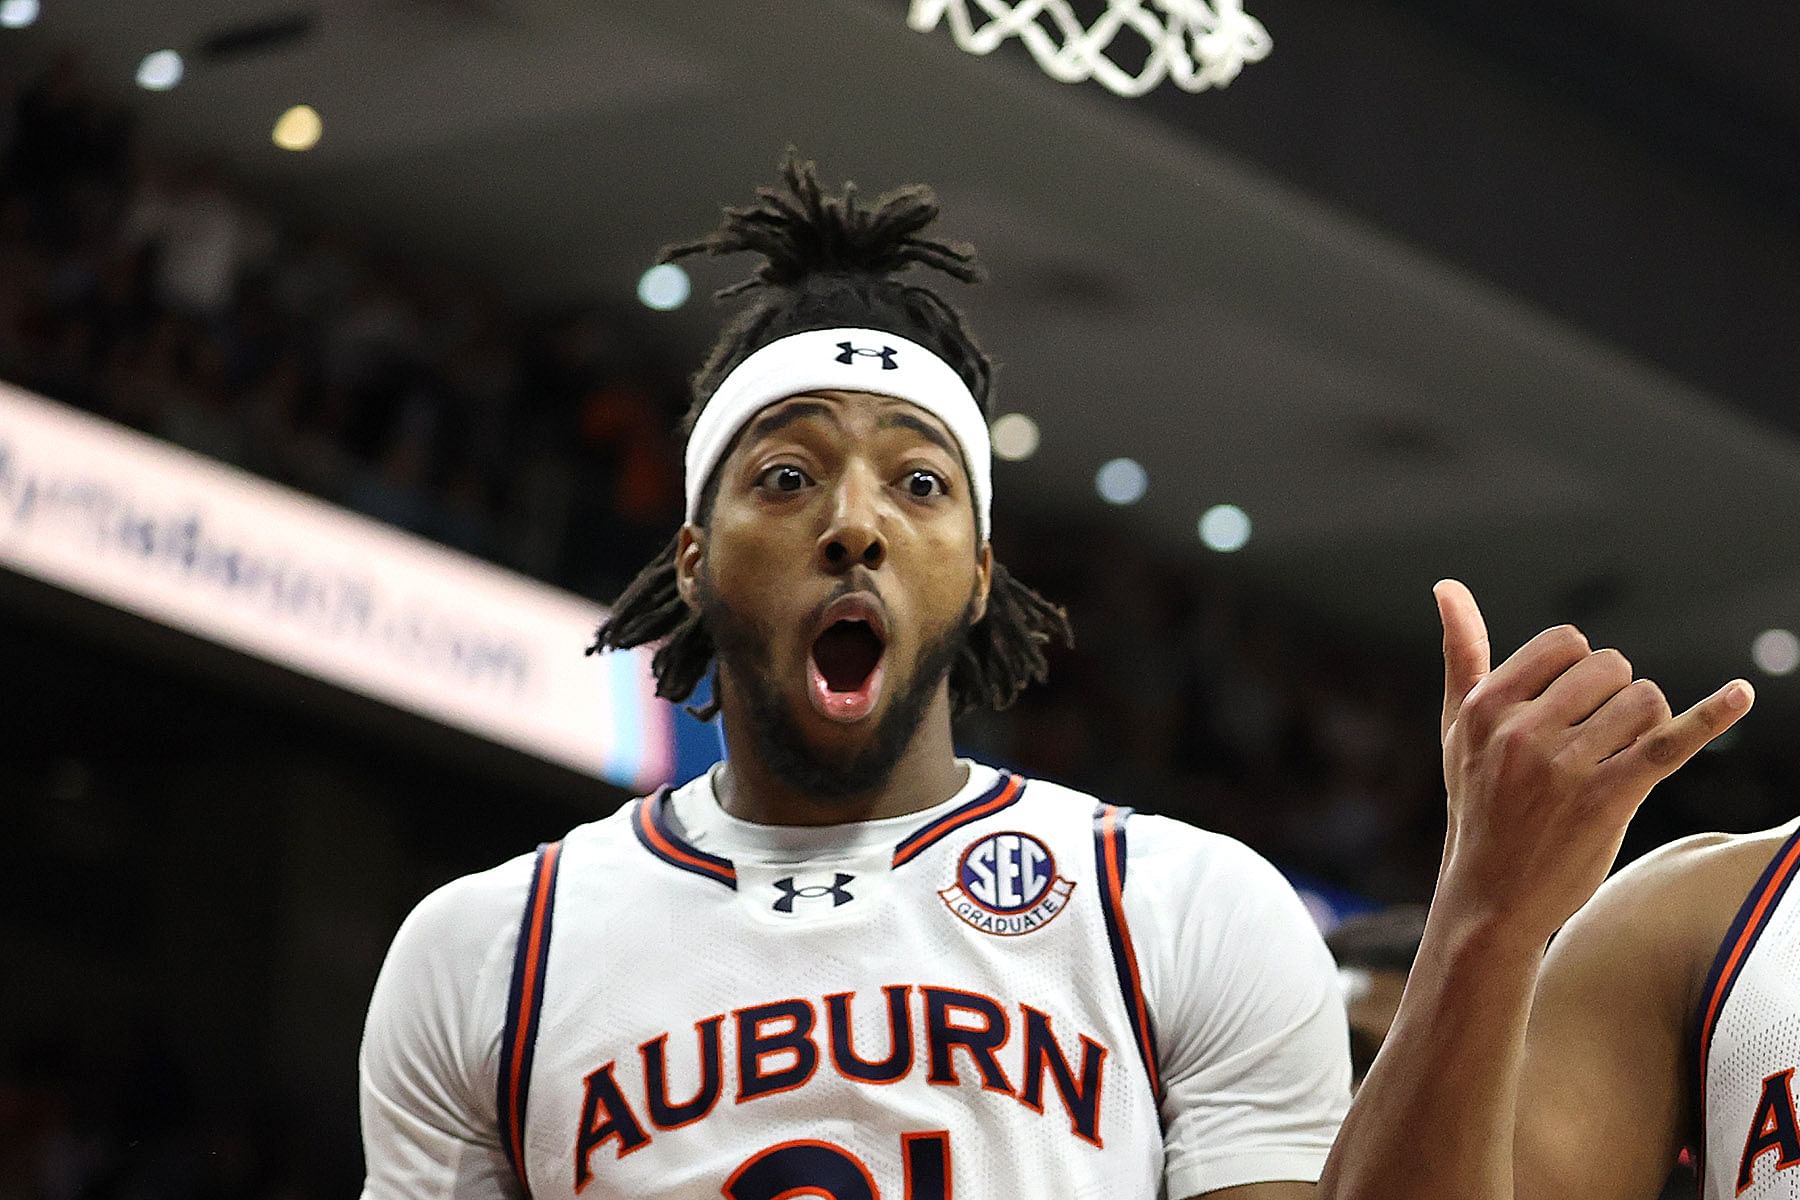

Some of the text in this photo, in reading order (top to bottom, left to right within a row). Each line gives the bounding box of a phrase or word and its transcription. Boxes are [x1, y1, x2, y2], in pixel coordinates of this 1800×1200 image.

[965, 834, 1049, 909] SEC
[957, 899, 1059, 933] GRADUATE
[575, 984, 1107, 1194] AUBURN
